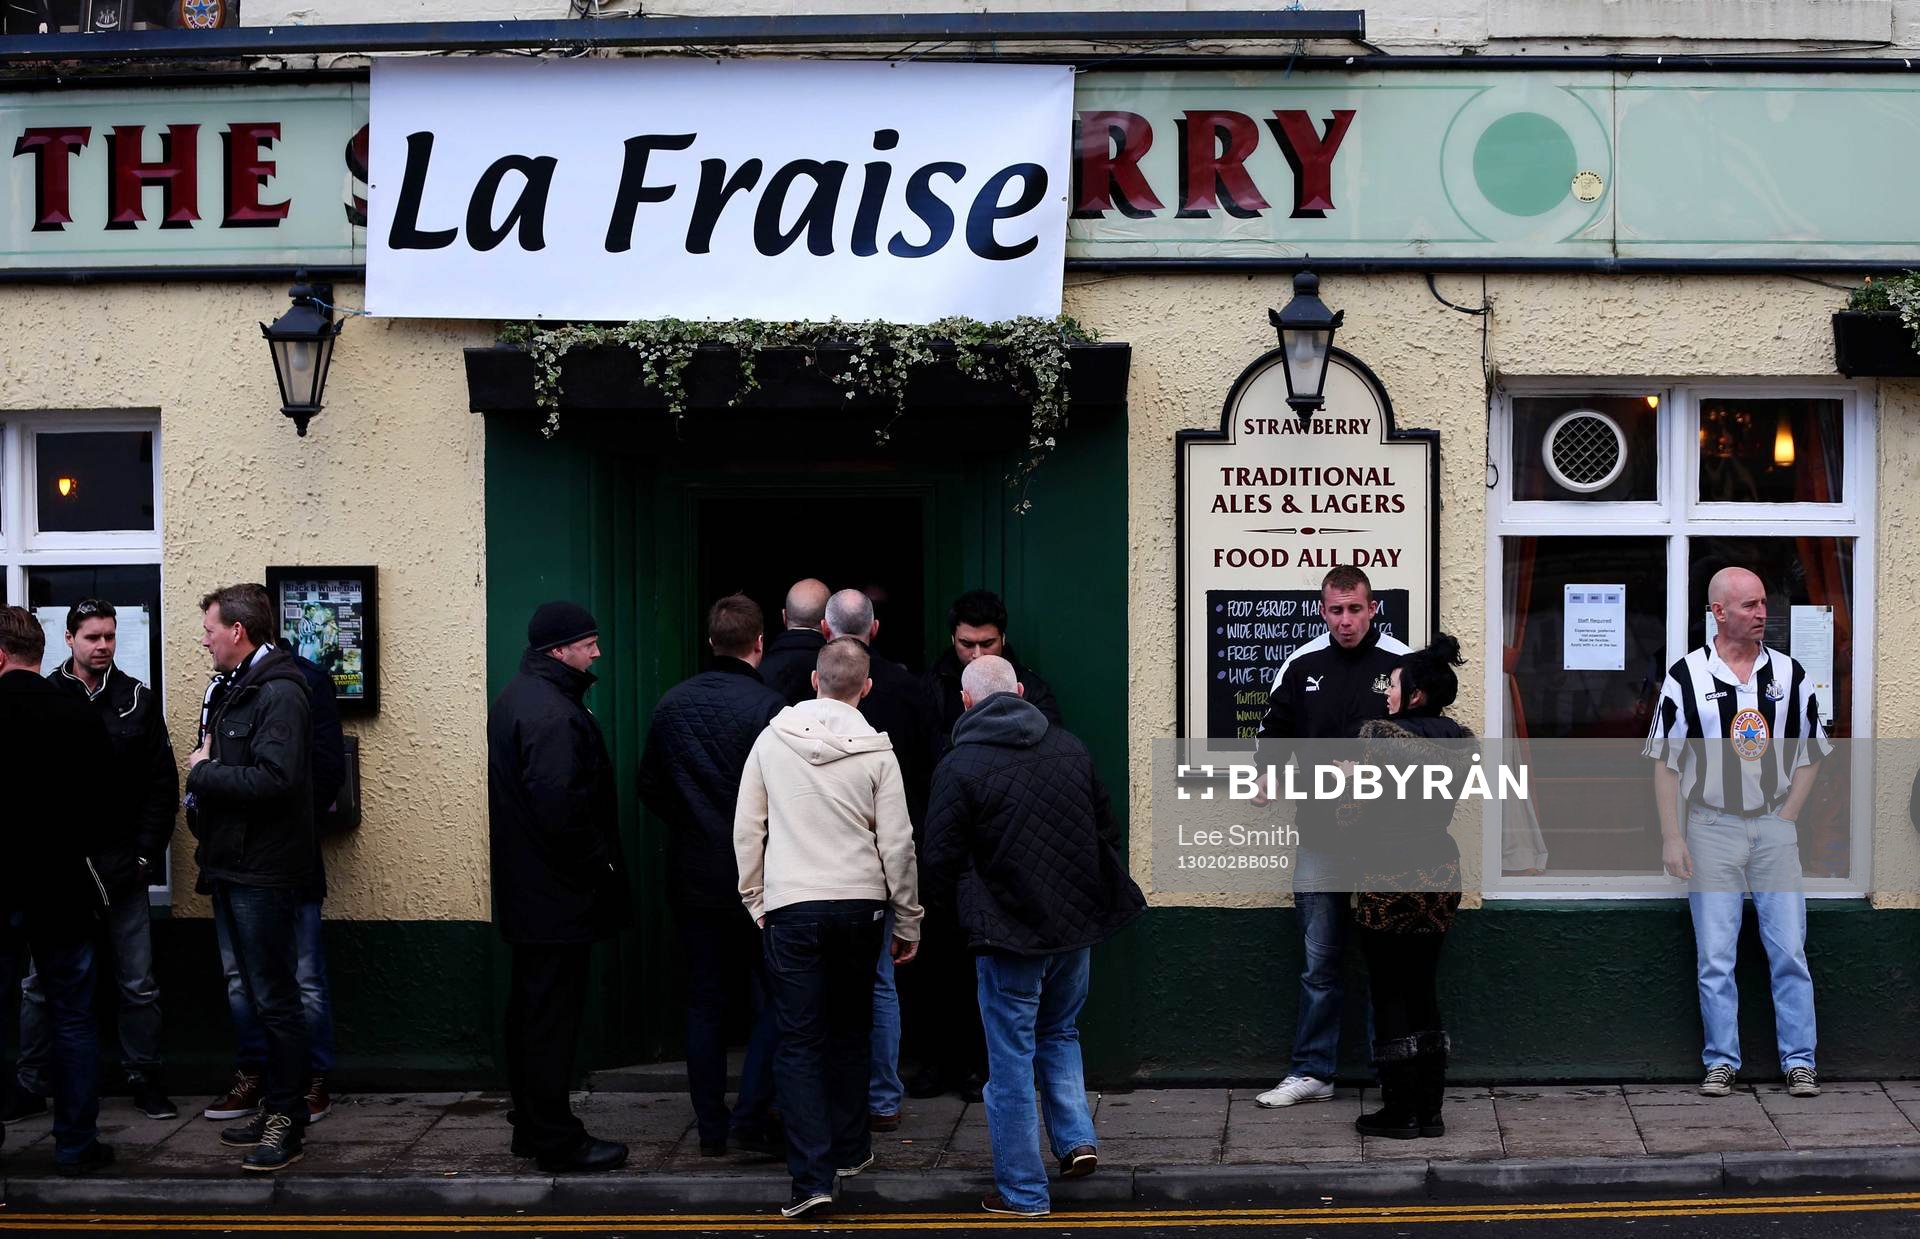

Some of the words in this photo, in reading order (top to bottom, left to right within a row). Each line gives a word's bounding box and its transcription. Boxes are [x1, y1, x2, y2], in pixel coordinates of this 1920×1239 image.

[13, 122, 291, 232] THE
[1071, 109, 1357, 219] RRY
[387, 131, 559, 253] La
[604, 128, 1050, 261] Fraise
[1243, 418, 1372, 435] STRAWBERRY
[1219, 467, 1396, 486] TRADITIONAL
[1210, 494, 1273, 513] ALES
[1281, 494, 1304, 513] &
[1311, 494, 1406, 513] LAGERS
[1213, 548, 1290, 567] FOOD
[1297, 548, 1343, 567] ALL
[1352, 548, 1402, 567] DAY
[1227, 600, 1253, 617] FOOD
[1255, 600, 1297, 617] SERVED
[1227, 623, 1253, 639] WIDE
[1254, 622, 1290, 639] RANGE
[1291, 623, 1306, 638] OF
[1307, 623, 1329, 639] LOCA
[1227, 645, 1262, 661] FREE
[1228, 667, 1257, 684] LIVE
[1707, 691, 1728, 700] adidas
[1735, 713, 1764, 730] NEWCASTLE
[1735, 738, 1758, 756] BROWN
